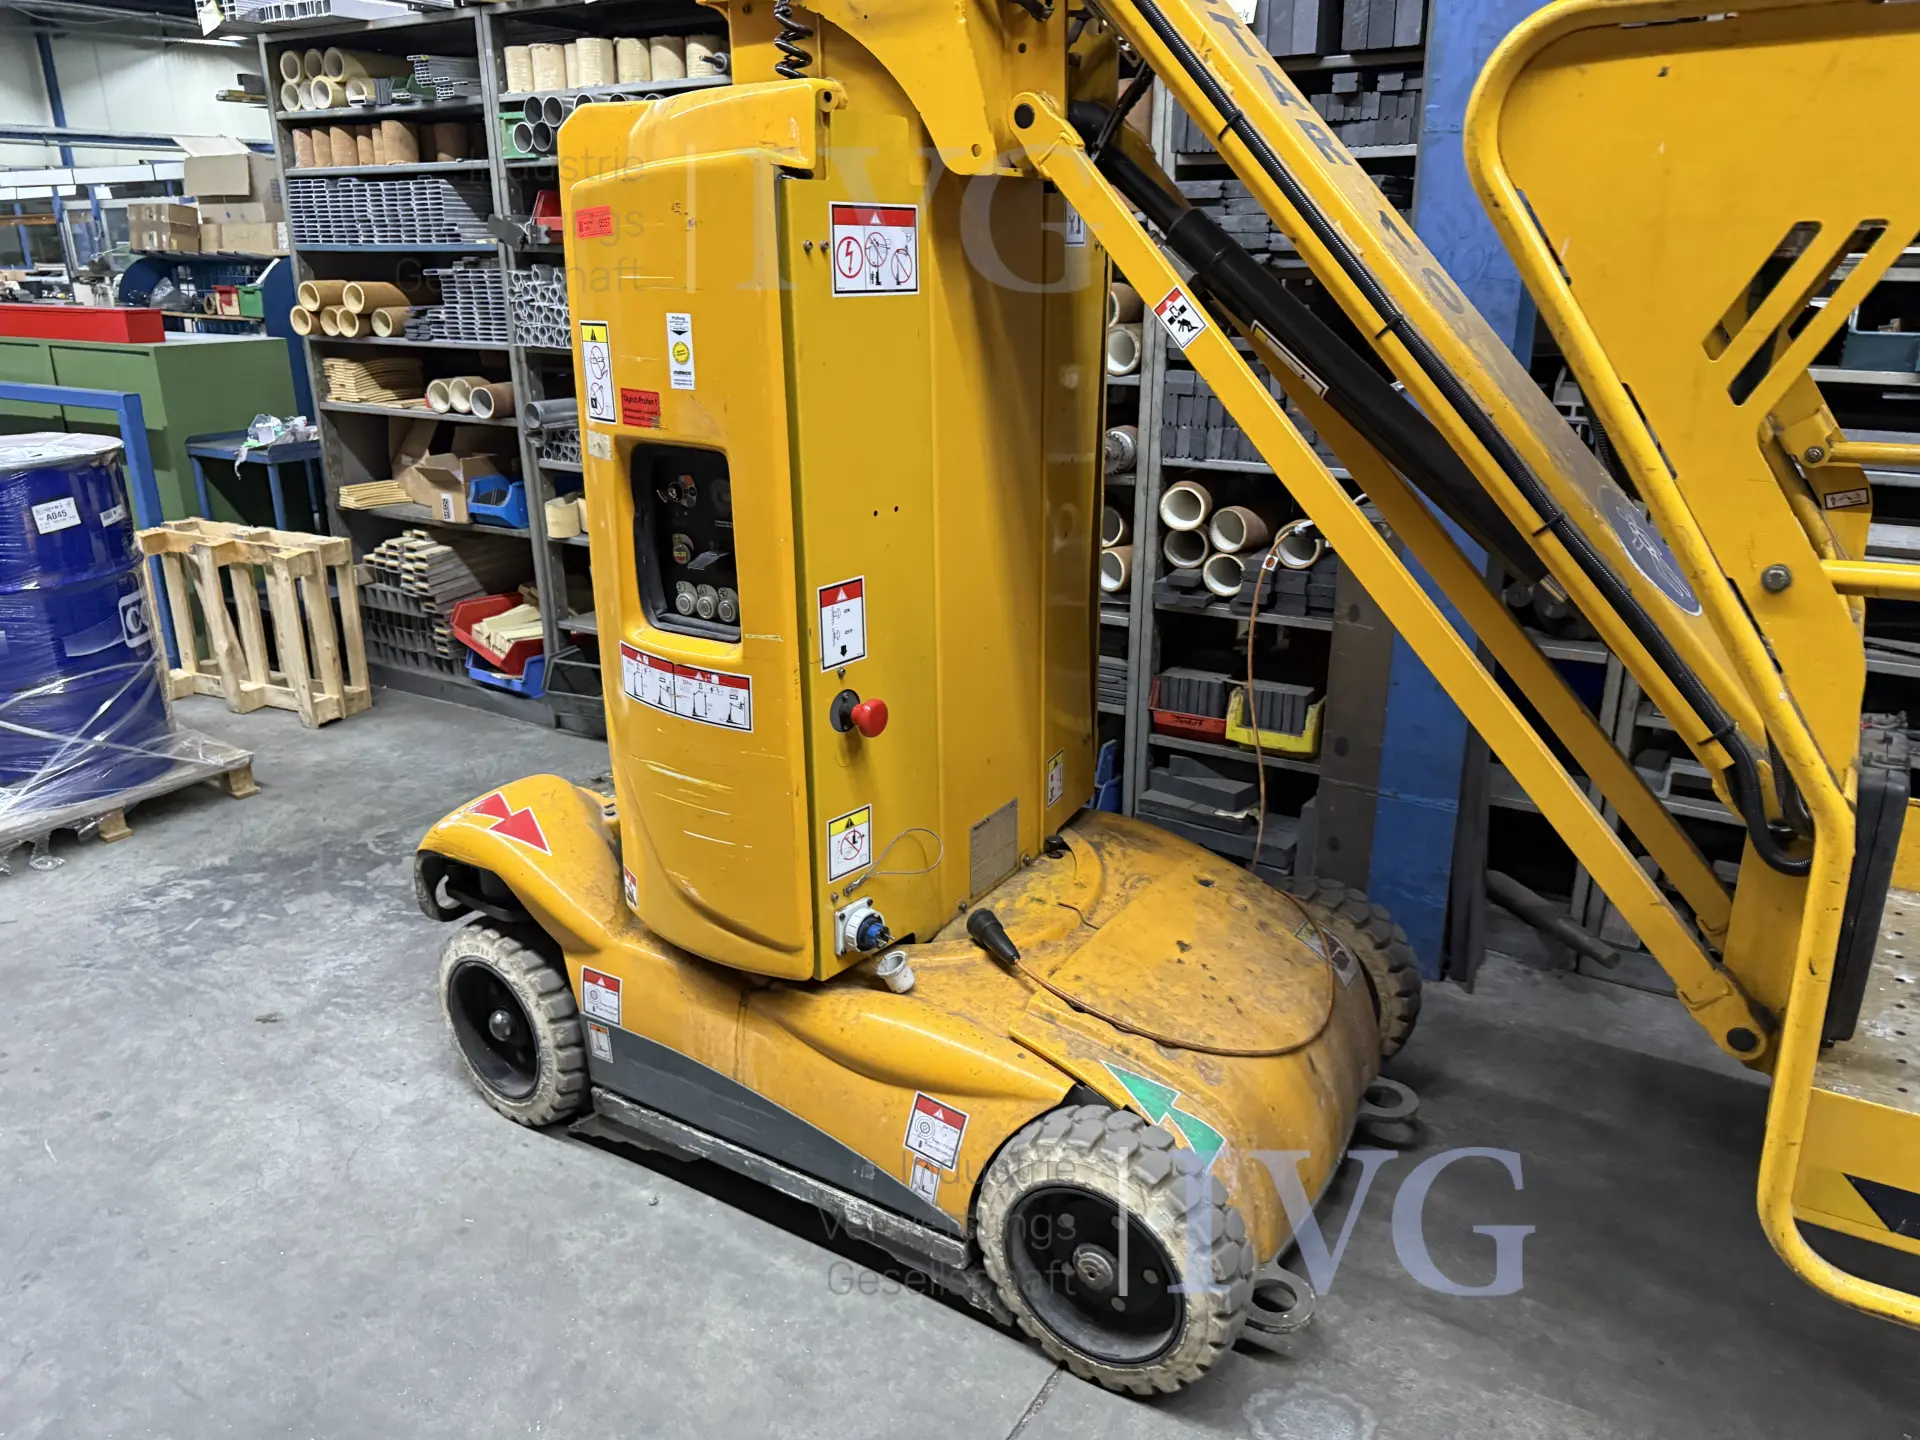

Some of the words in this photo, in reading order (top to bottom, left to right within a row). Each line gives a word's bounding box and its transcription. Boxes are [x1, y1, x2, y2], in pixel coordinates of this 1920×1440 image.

[1204, 0, 1354, 166] TAR
[1377, 209, 1466, 315] 10
[46, 510, 67, 521] A045
